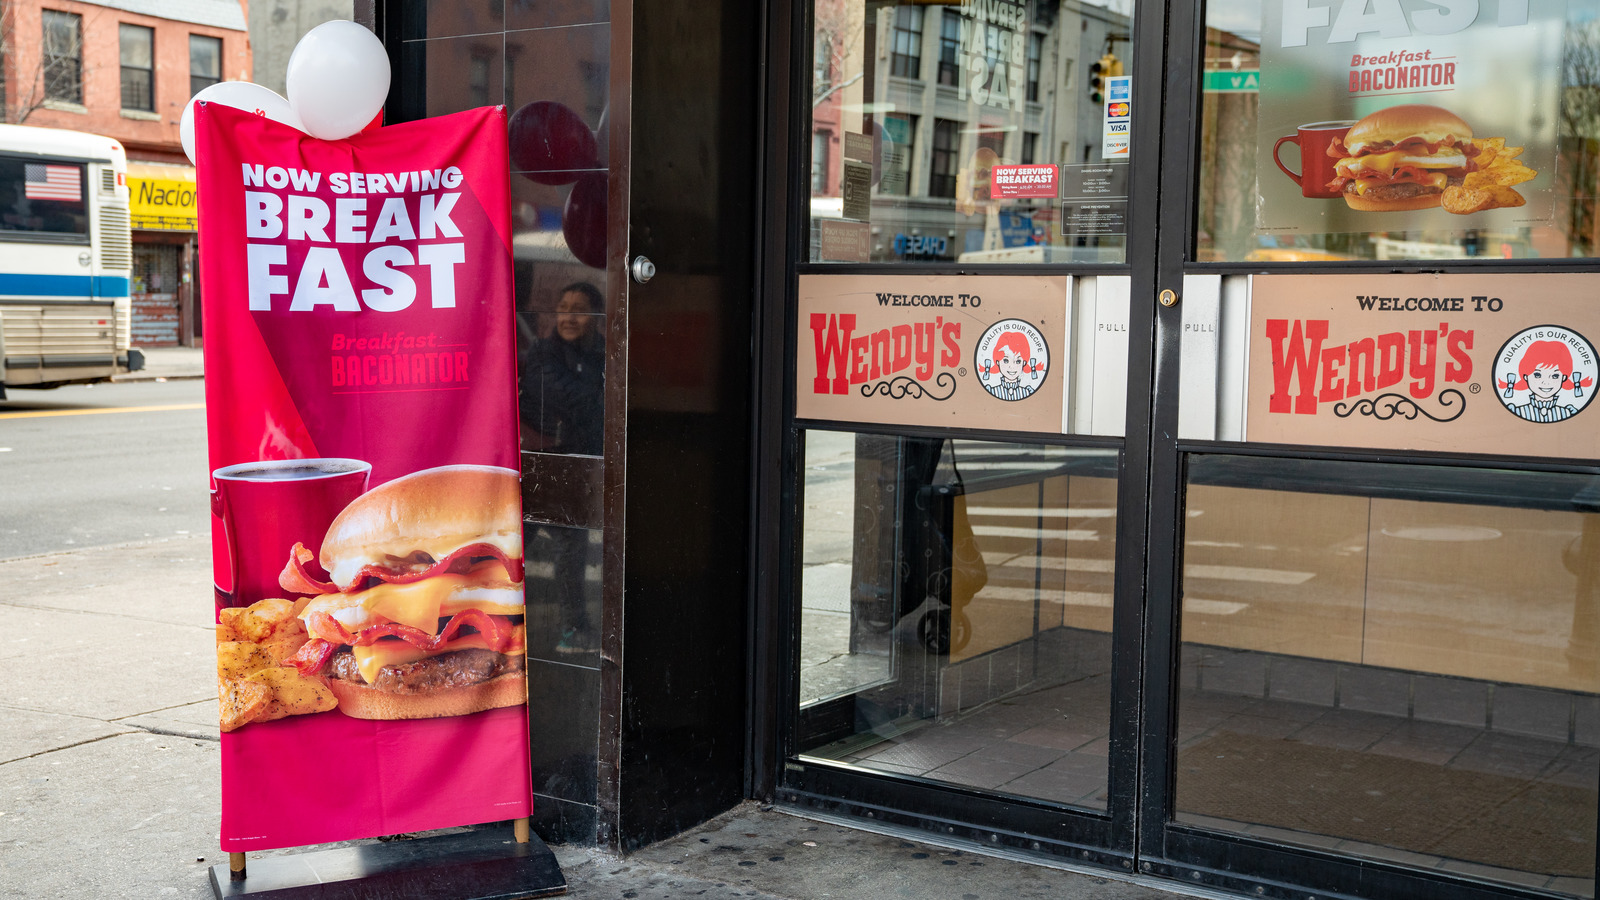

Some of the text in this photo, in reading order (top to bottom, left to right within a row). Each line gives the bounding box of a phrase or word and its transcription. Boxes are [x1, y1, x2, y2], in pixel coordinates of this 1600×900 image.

[1350, 49, 1431, 67] Breakfast
[1348, 62, 1455, 92] BACONATOR
[1110, 124, 1127, 132] VISA
[242, 163, 464, 194] NOW SERVING
[996, 175, 1053, 184] BREAKFAST
[245, 190, 464, 243] BREAK
[247, 242, 466, 312] FAST
[876, 293, 981, 308] WELCOME TO
[1356, 295, 1503, 312] WELCOME TO
[982, 326, 1002, 351] QUALITY
[1011, 323, 1026, 332] OUR
[1026, 329, 1043, 353] RECIPE
[1099, 323, 1126, 332] PULL
[1185, 323, 1214, 332] PULL
[331, 331, 437, 354] Breakfast
[1503, 331, 1592, 366] QUALITY IS OUR RECIPE
[331, 351, 469, 386] BACONATOR
